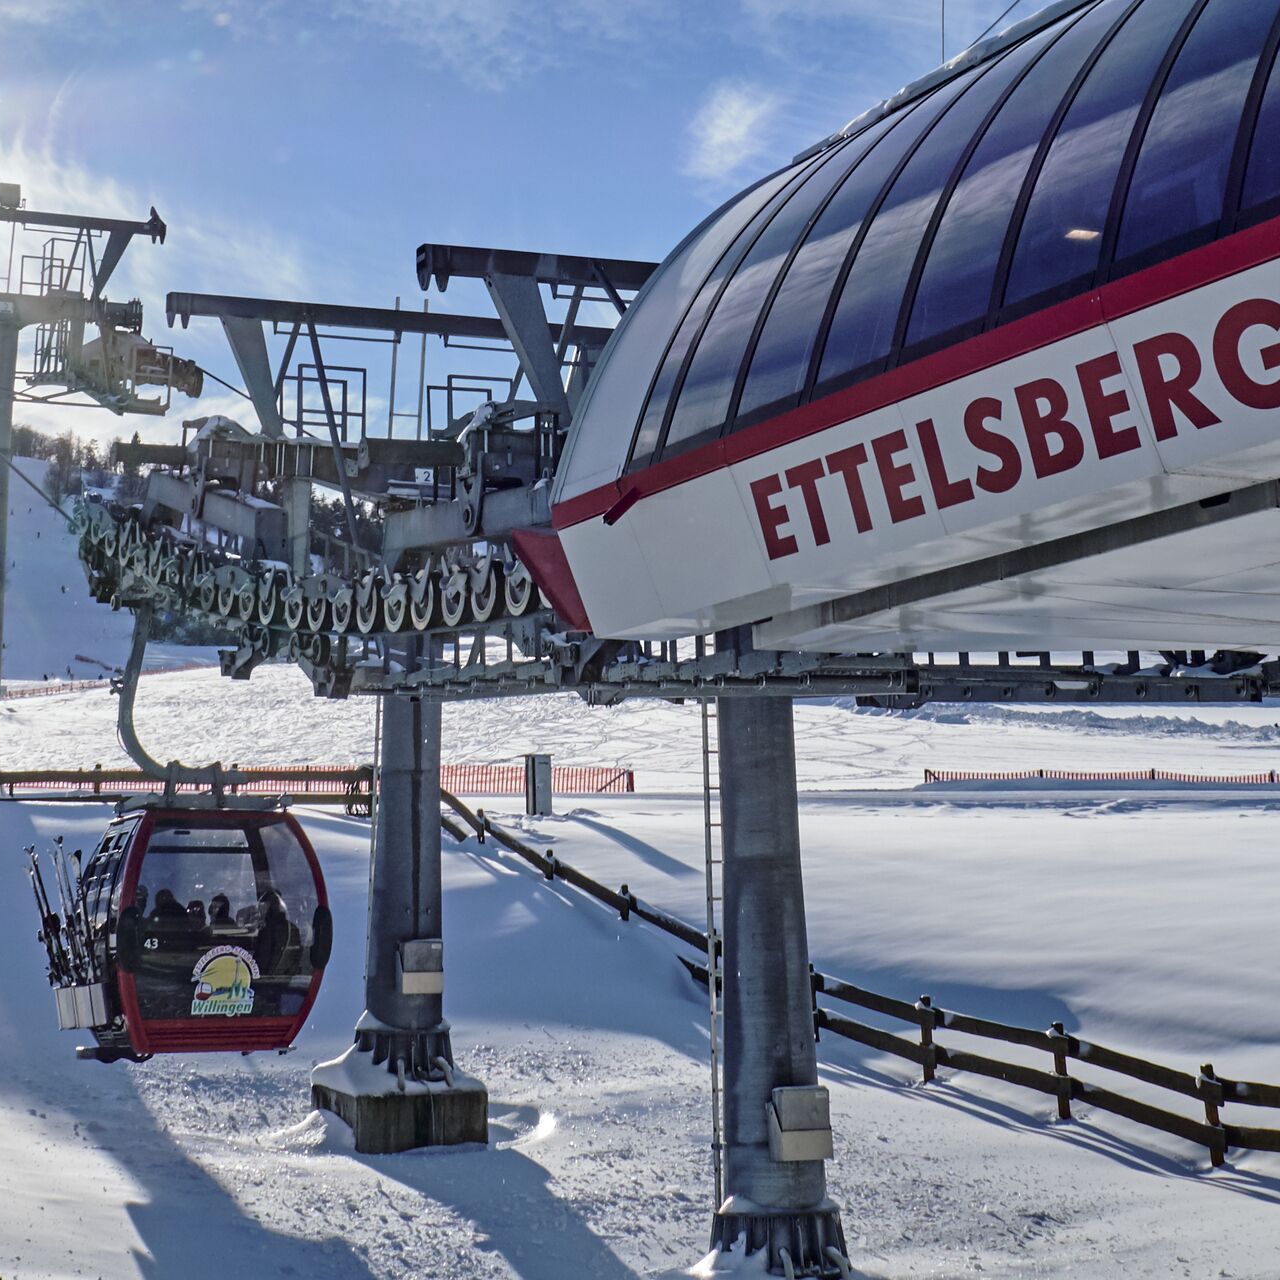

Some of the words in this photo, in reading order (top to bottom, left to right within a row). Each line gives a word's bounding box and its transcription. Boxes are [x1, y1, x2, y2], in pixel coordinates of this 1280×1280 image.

[423, 470, 431, 482] 2
[143, 938, 159, 949] 43
[193, 999, 252, 1015] Willingen
